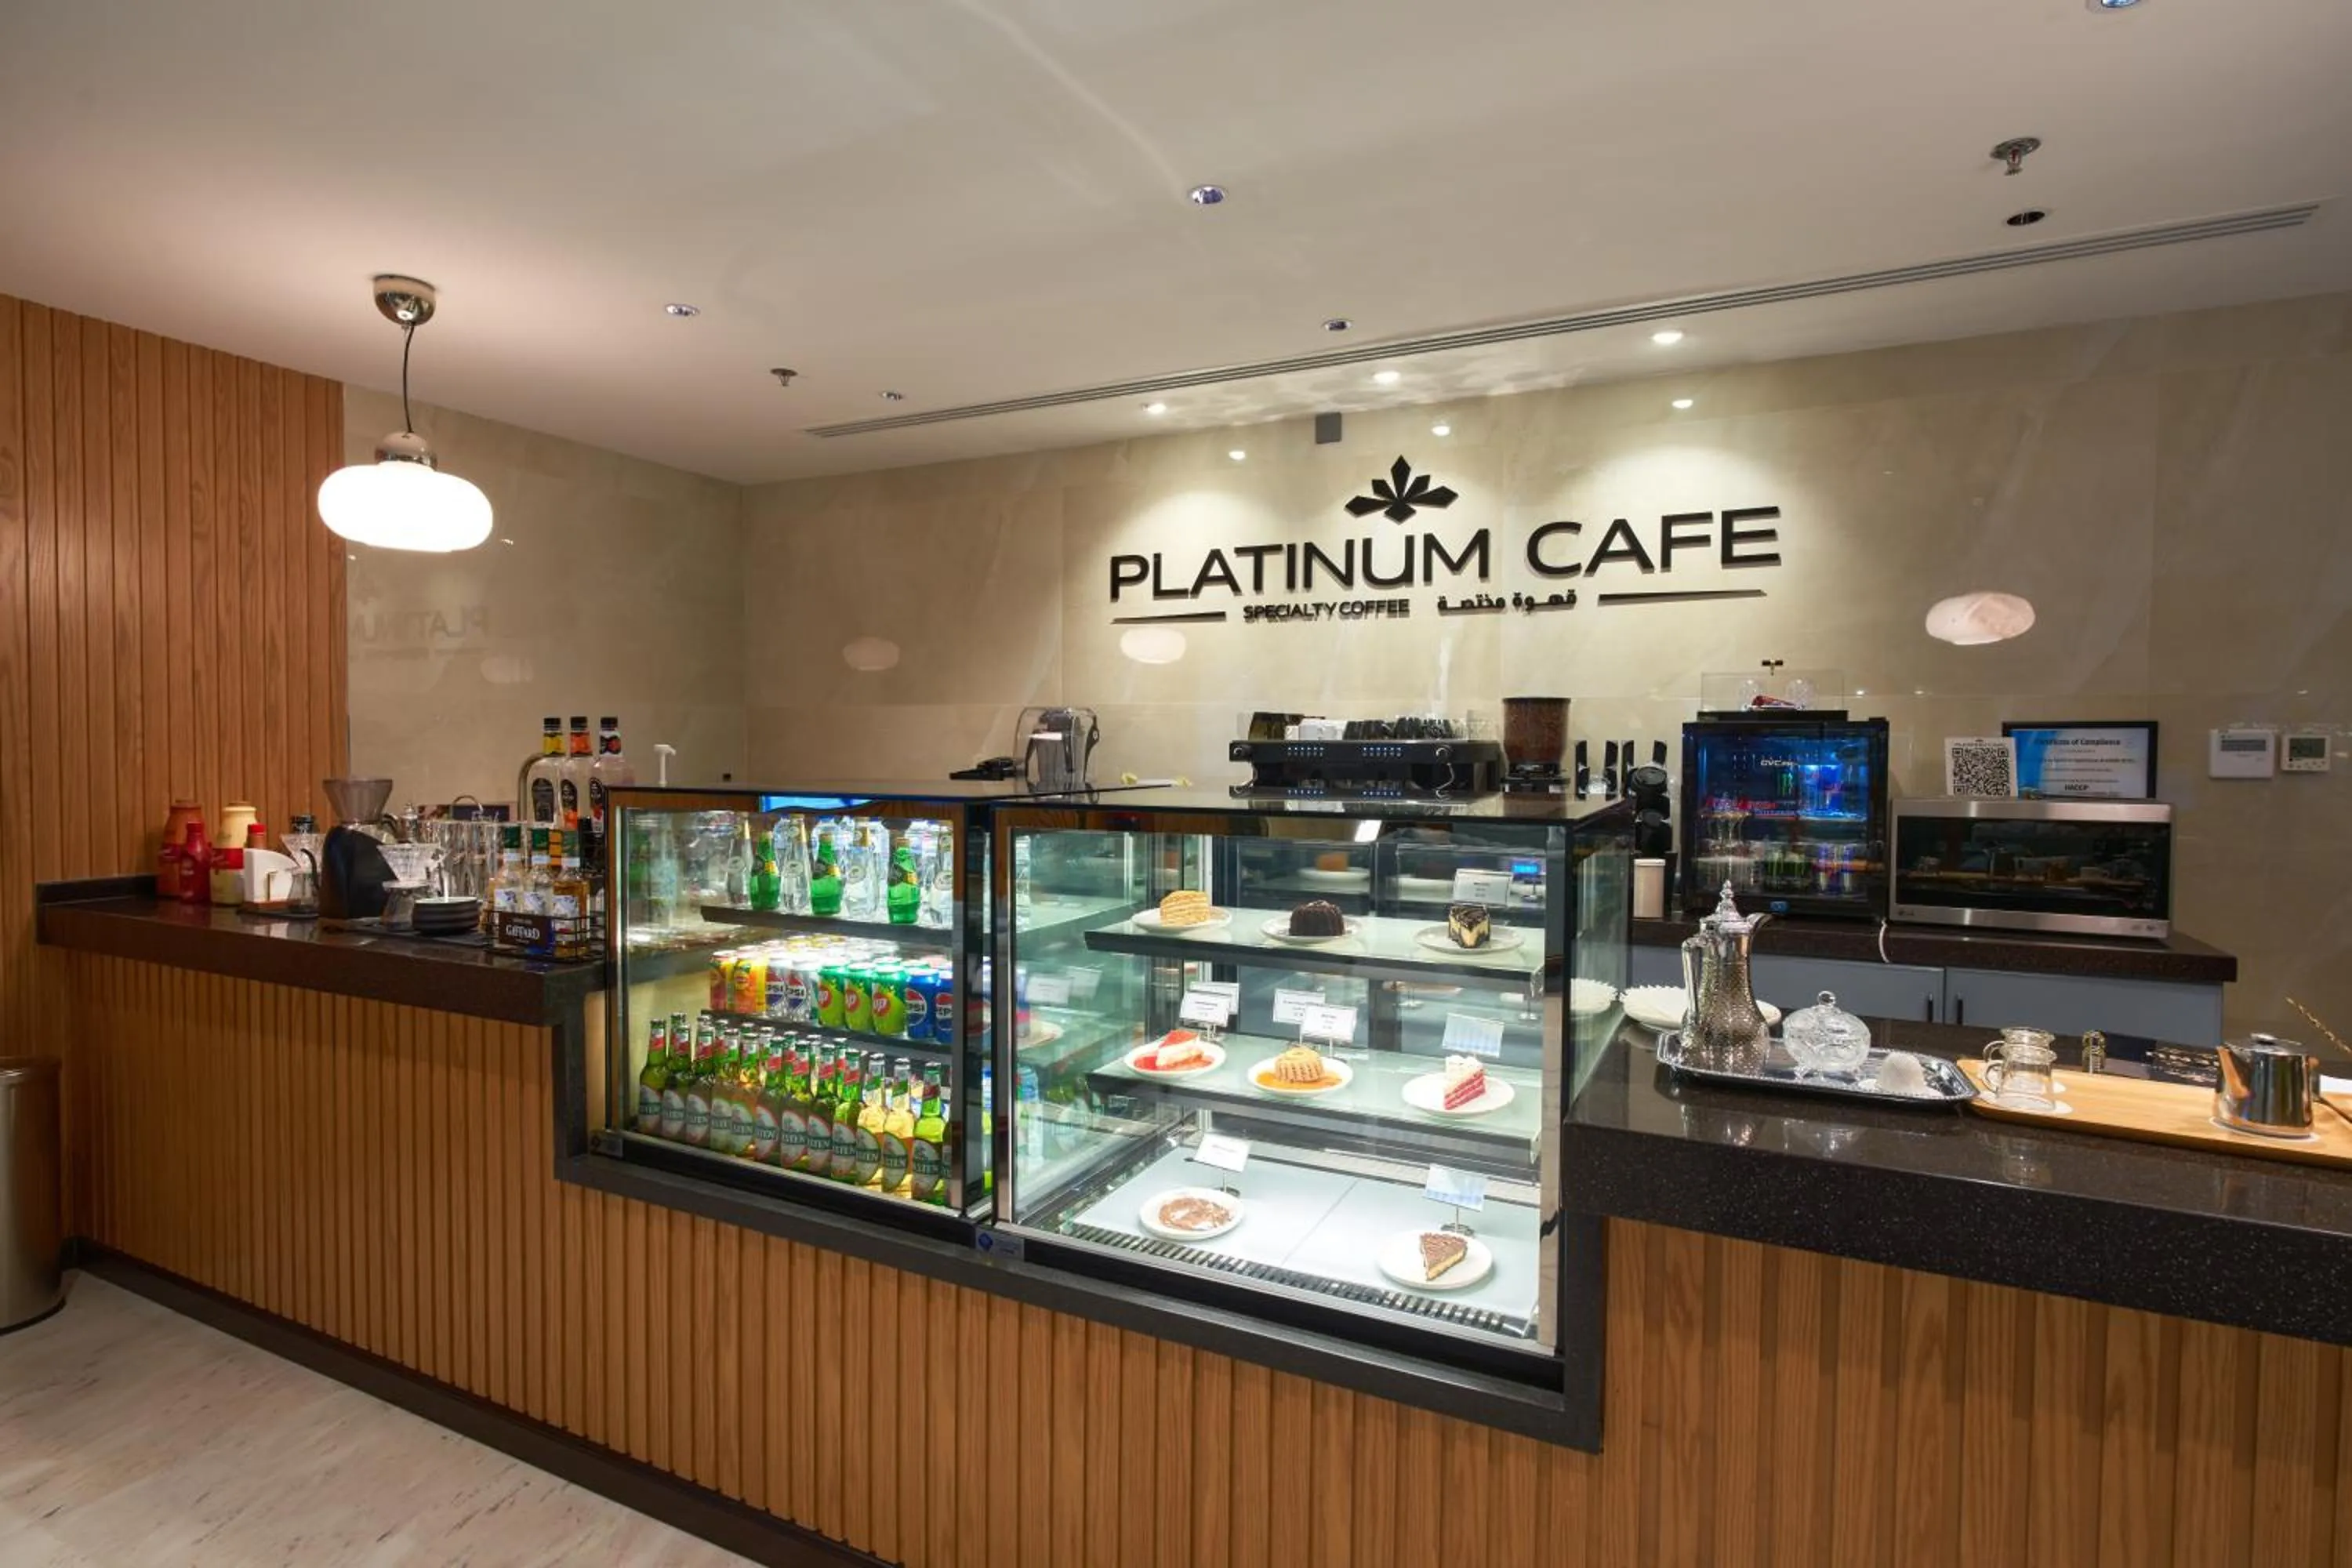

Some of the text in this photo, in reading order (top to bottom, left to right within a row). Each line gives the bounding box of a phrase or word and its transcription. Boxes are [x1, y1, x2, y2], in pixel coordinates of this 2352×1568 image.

[1110, 506, 1780, 601] PLATINUM CAFE
[1243, 598, 1410, 621] SPECIALTY COFFEE
[1436, 589, 1578, 612] قهوة مختصة
